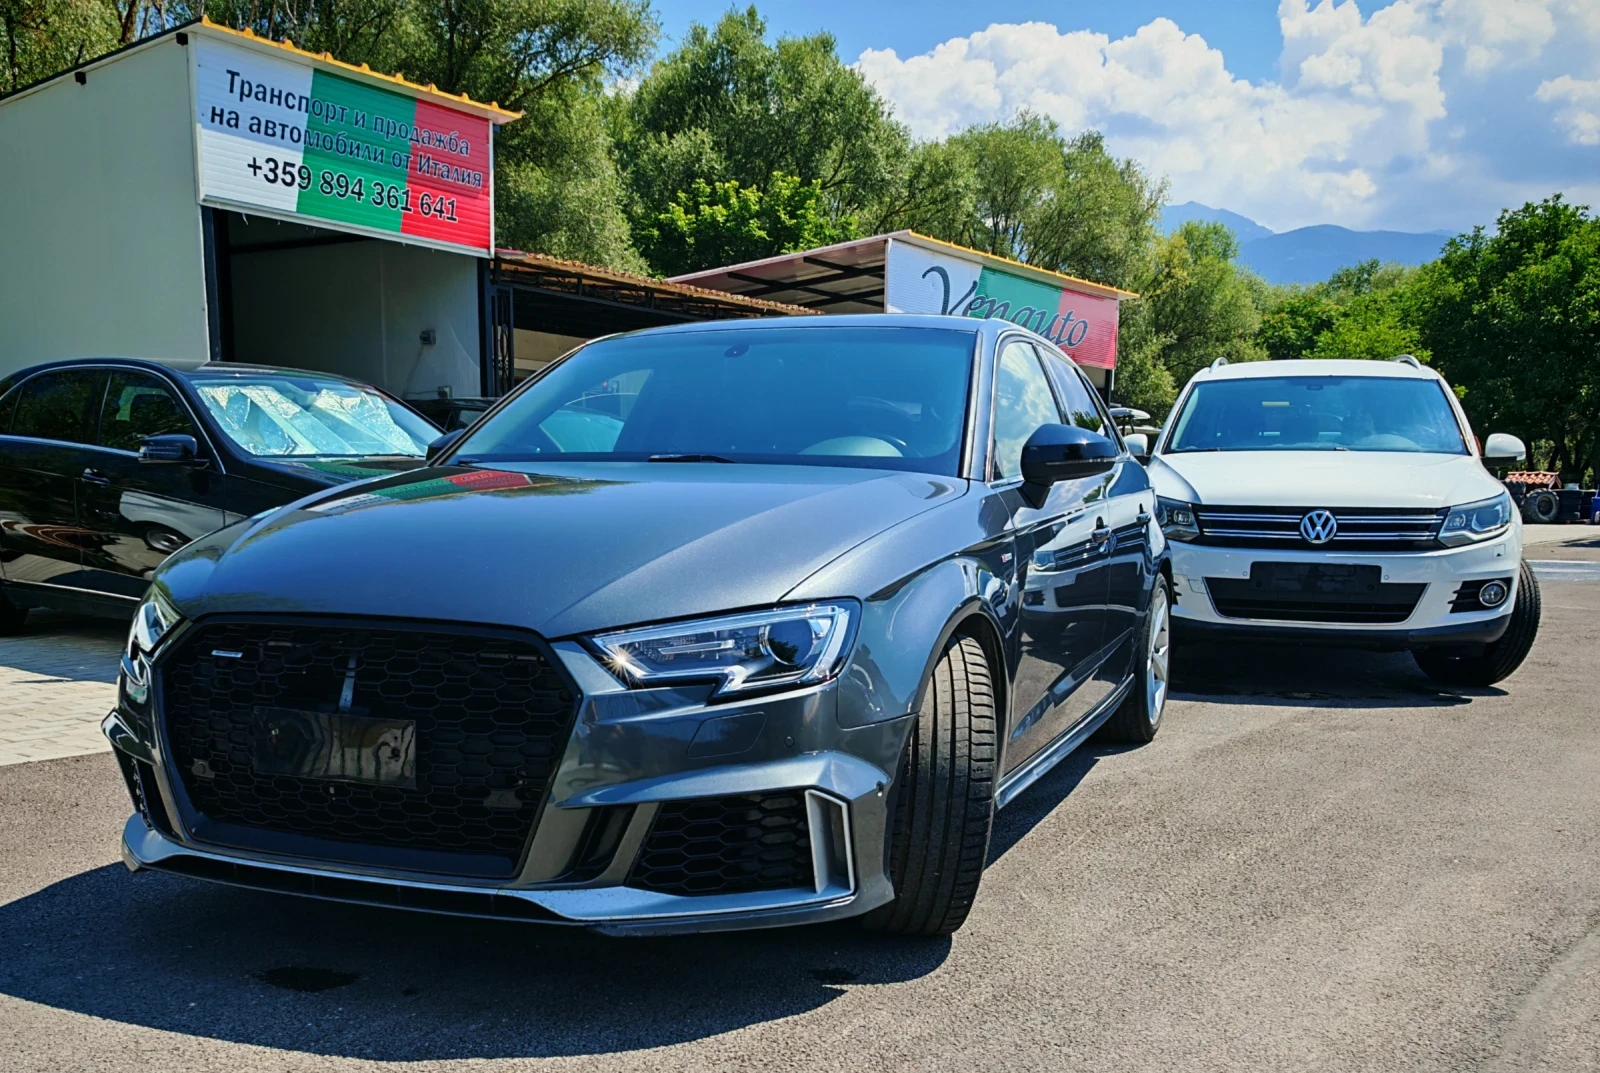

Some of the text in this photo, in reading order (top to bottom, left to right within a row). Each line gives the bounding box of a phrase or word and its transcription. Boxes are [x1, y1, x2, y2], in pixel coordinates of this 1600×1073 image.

[210, 106, 483, 188] на автомобили от Италия
[226, 69, 470, 156] Транспорт и продажба
[247, 156, 459, 223] +359 894 361 641
[1300, 510, 1337, 543] VW
